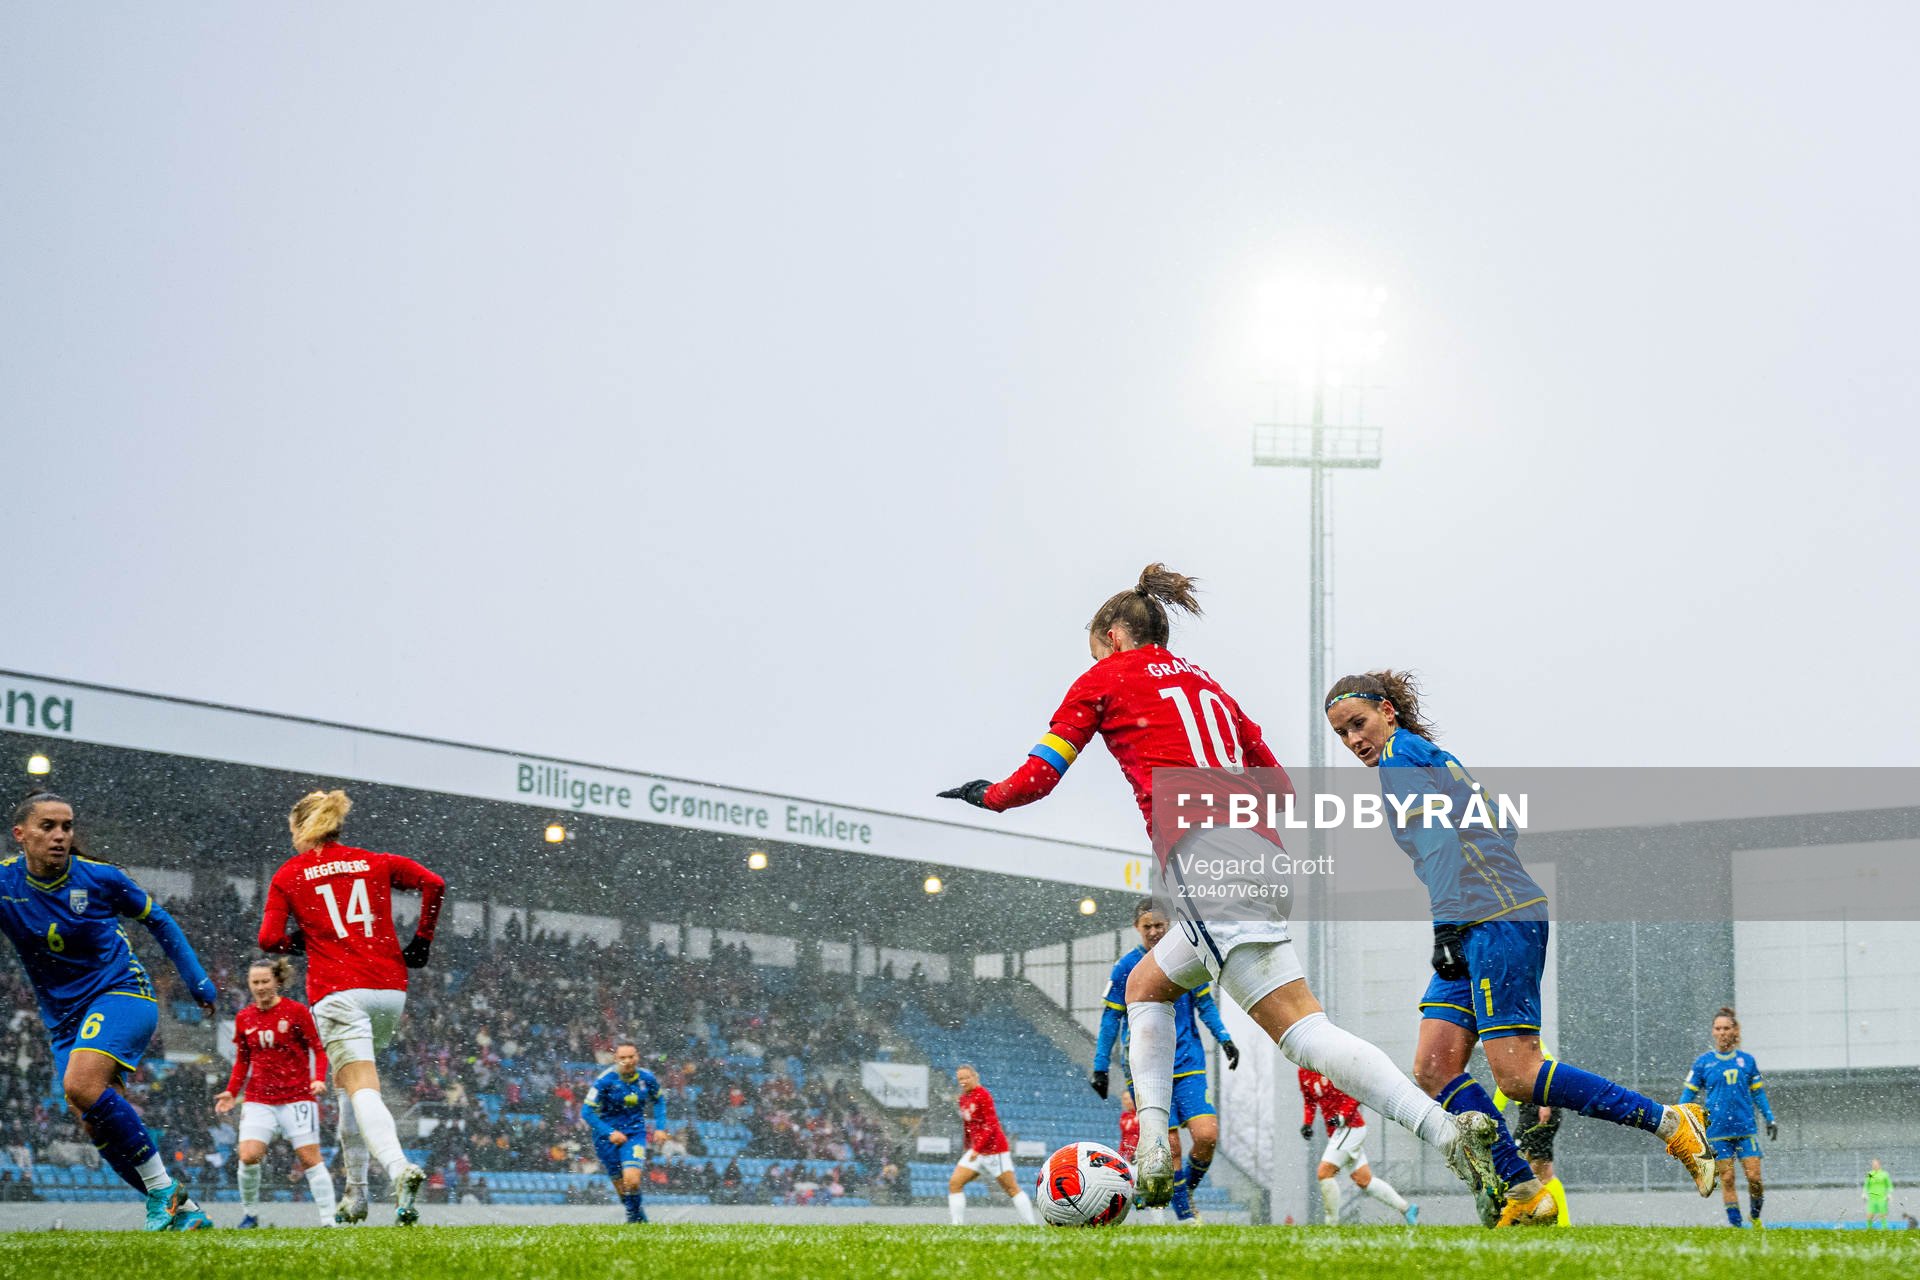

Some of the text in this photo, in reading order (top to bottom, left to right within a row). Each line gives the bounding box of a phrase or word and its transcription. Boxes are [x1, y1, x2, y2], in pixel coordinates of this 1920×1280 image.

[0, 690, 73, 732] na
[1158, 686, 1244, 775] 10
[517, 763, 872, 844] Billigere Grønnere Enklere
[304, 860, 370, 880] HEGERBERG
[315, 879, 374, 938] 14
[47, 922, 65, 952] 6
[80, 1012, 105, 1040] 6
[258, 1029, 275, 1048] 19
[1723, 1069, 1739, 1085] 17
[294, 1103, 309, 1121] 19
